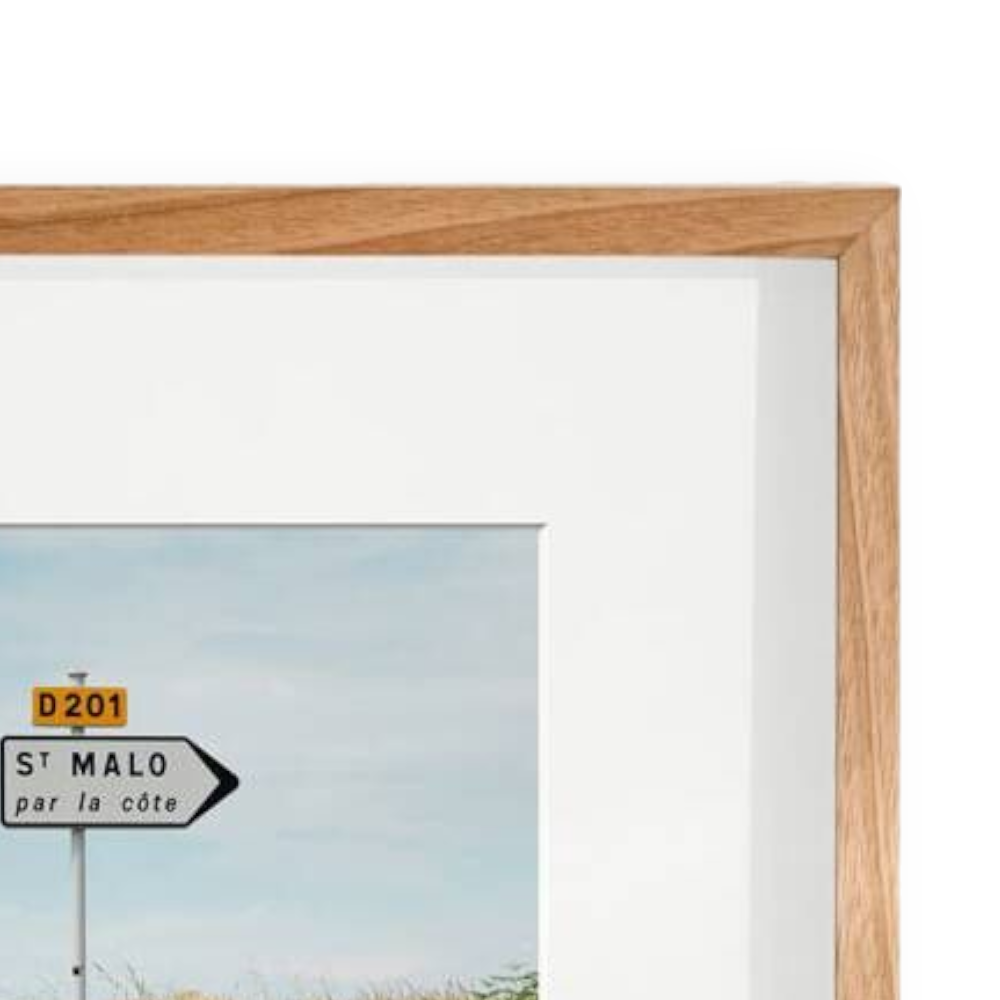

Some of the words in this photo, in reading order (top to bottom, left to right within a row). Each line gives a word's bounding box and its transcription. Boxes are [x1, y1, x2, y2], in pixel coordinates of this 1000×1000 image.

[71, 751, 168, 777] MALO
[14, 797, 58, 817] par
[78, 791, 101, 812] la
[122, 791, 178, 813] côte
